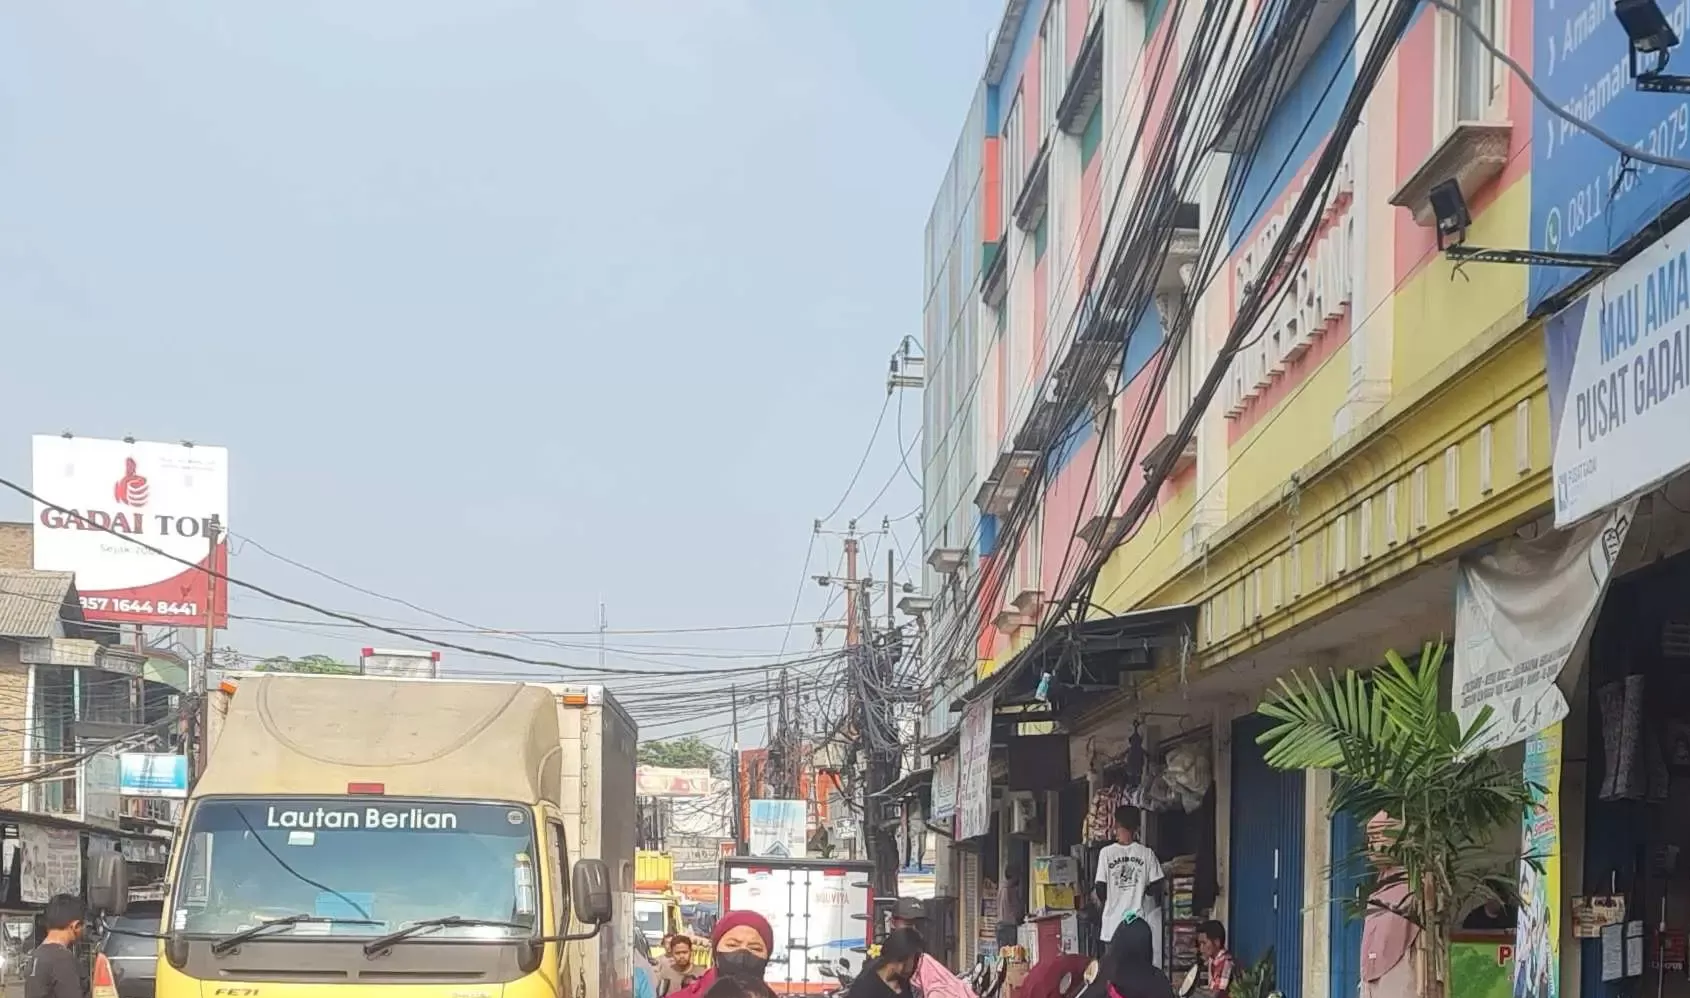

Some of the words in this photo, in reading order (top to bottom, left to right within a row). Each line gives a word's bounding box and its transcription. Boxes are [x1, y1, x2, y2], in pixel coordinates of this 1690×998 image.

[1568, 175, 1600, 237] 0811
[1599, 284, 1640, 366] MAU
[1576, 364, 1629, 450] PUSAT
[1633, 324, 1690, 417] GADAI
[40, 507, 144, 535] GADAI
[112, 598, 154, 614] 1644
[157, 601, 197, 616] 8441
[267, 806, 359, 828] Lautan
[365, 808, 457, 829] Berlian
[214, 988, 260, 997] FE71
